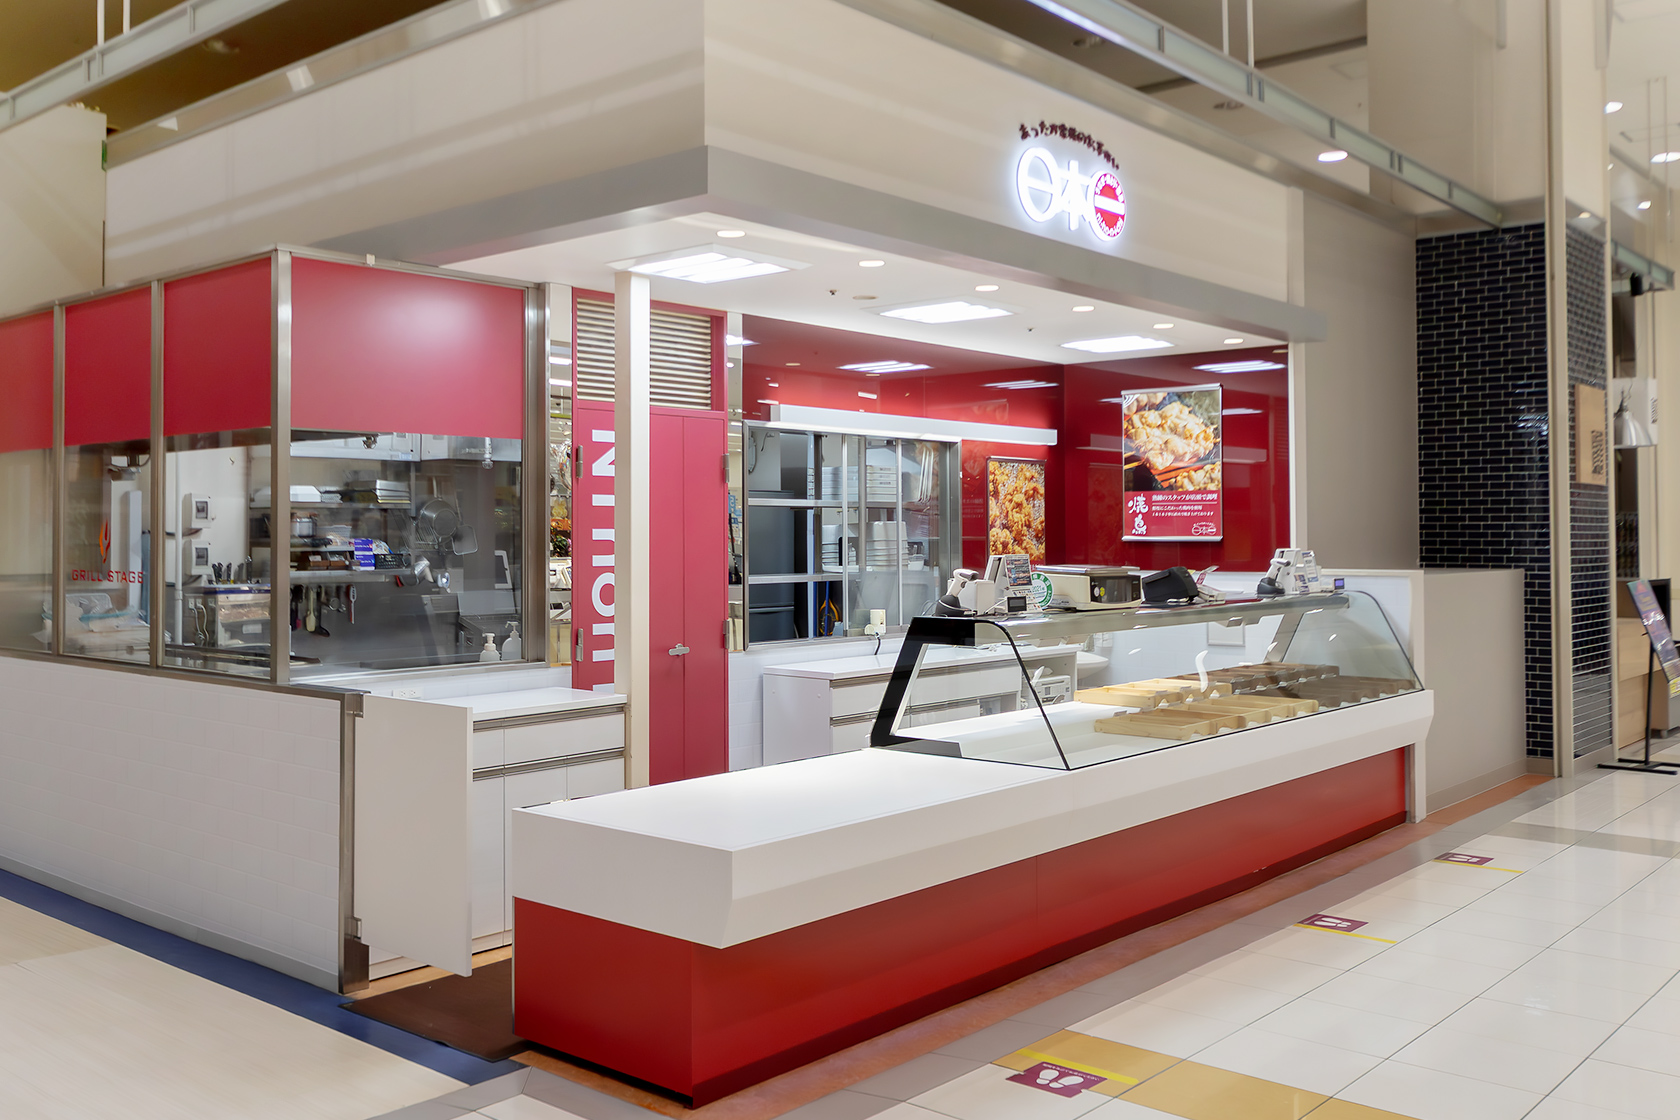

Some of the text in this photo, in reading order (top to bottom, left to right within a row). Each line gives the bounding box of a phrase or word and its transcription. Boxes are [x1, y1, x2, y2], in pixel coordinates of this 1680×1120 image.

[1127, 493, 1149, 535] 焼鳥
[71, 569, 144, 584] GRILL STAGE
